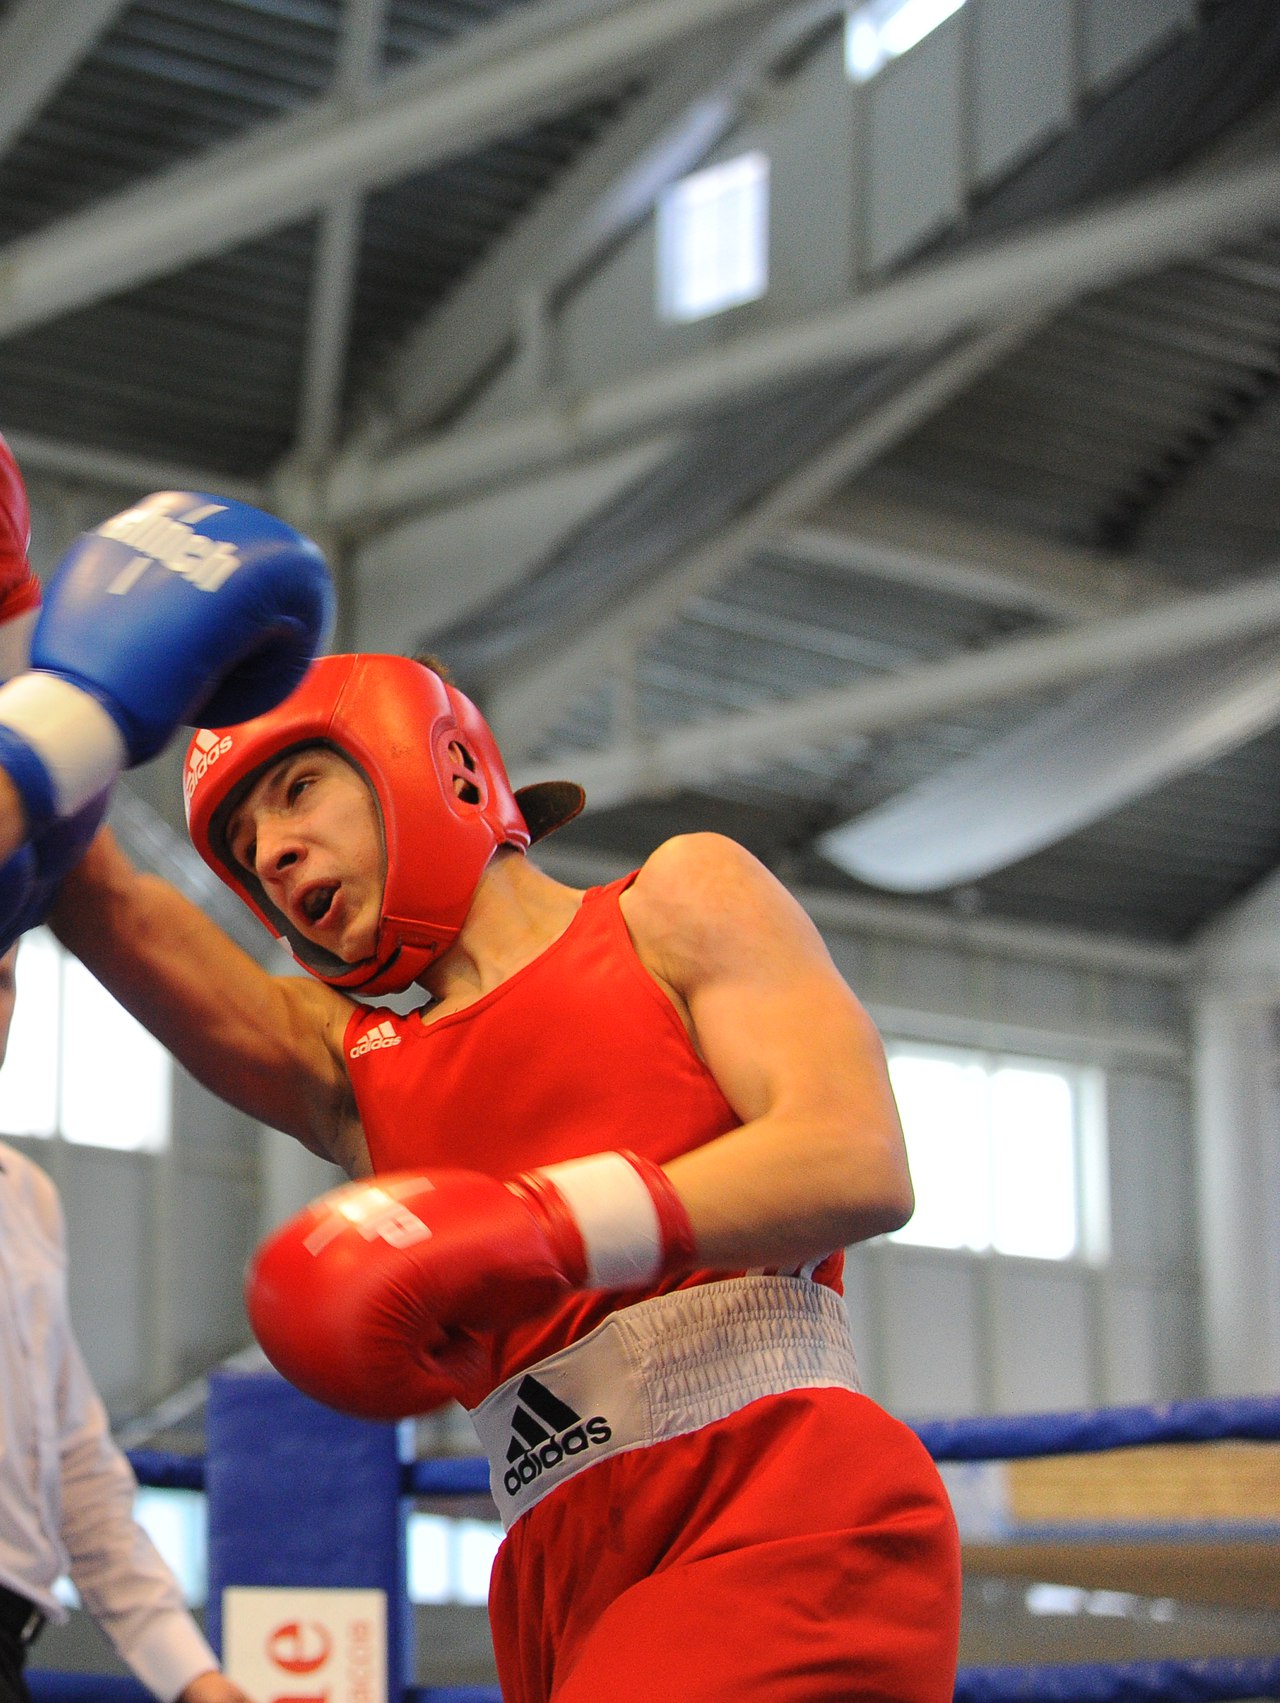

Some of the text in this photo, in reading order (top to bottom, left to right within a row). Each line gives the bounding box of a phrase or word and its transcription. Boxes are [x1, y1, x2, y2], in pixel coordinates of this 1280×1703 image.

[185, 735, 233, 801] didas
[350, 1035, 402, 1059] adidas
[504, 1416, 612, 1496] adidas
